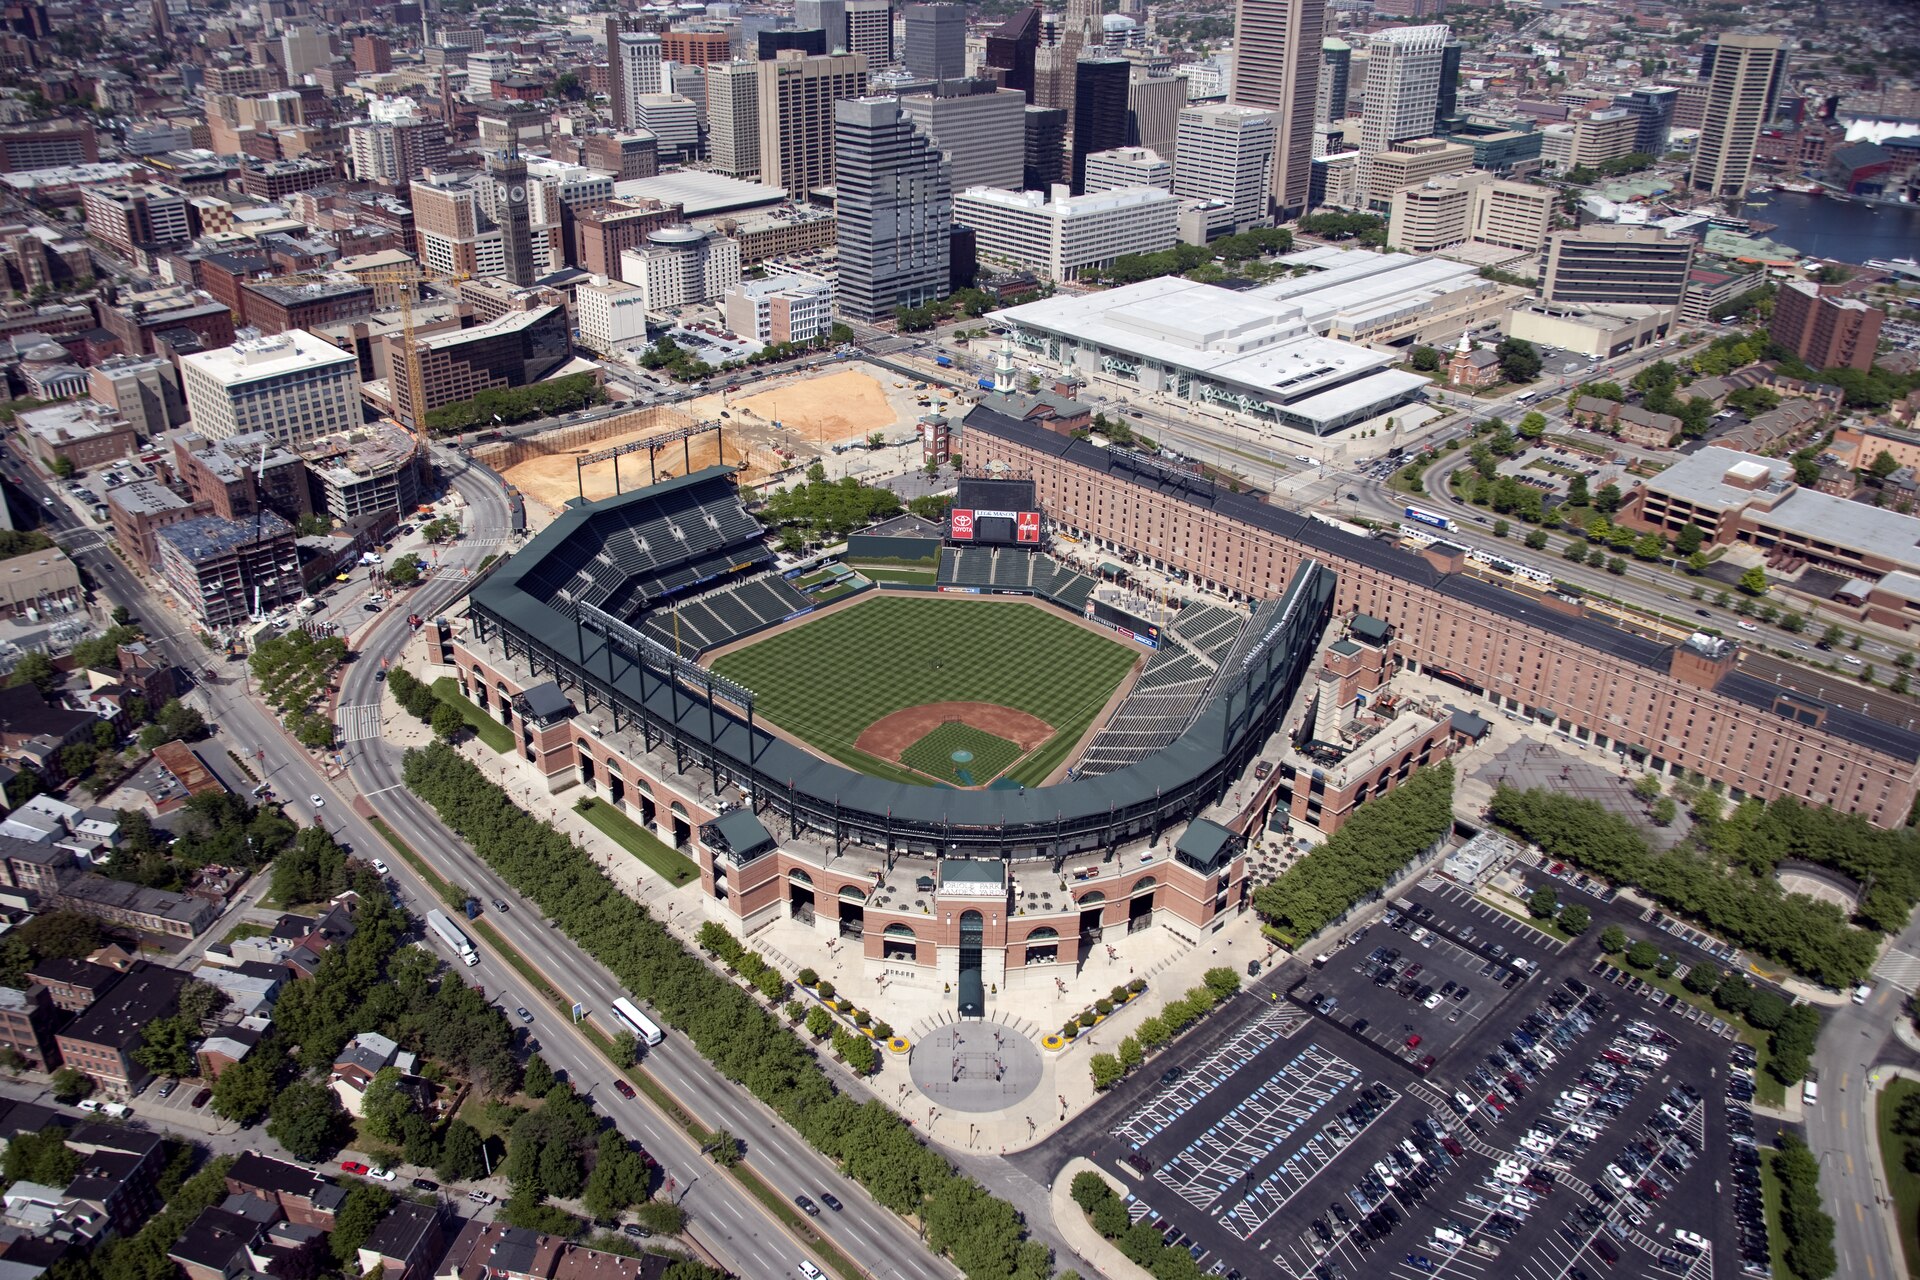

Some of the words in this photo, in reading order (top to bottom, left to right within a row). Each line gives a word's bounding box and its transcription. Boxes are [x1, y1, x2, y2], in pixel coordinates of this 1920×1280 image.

[1417, 513, 1440, 524] PEPSI
[1135, 635, 1153, 646] GEICO
[979, 882, 1000, 890] PARK
